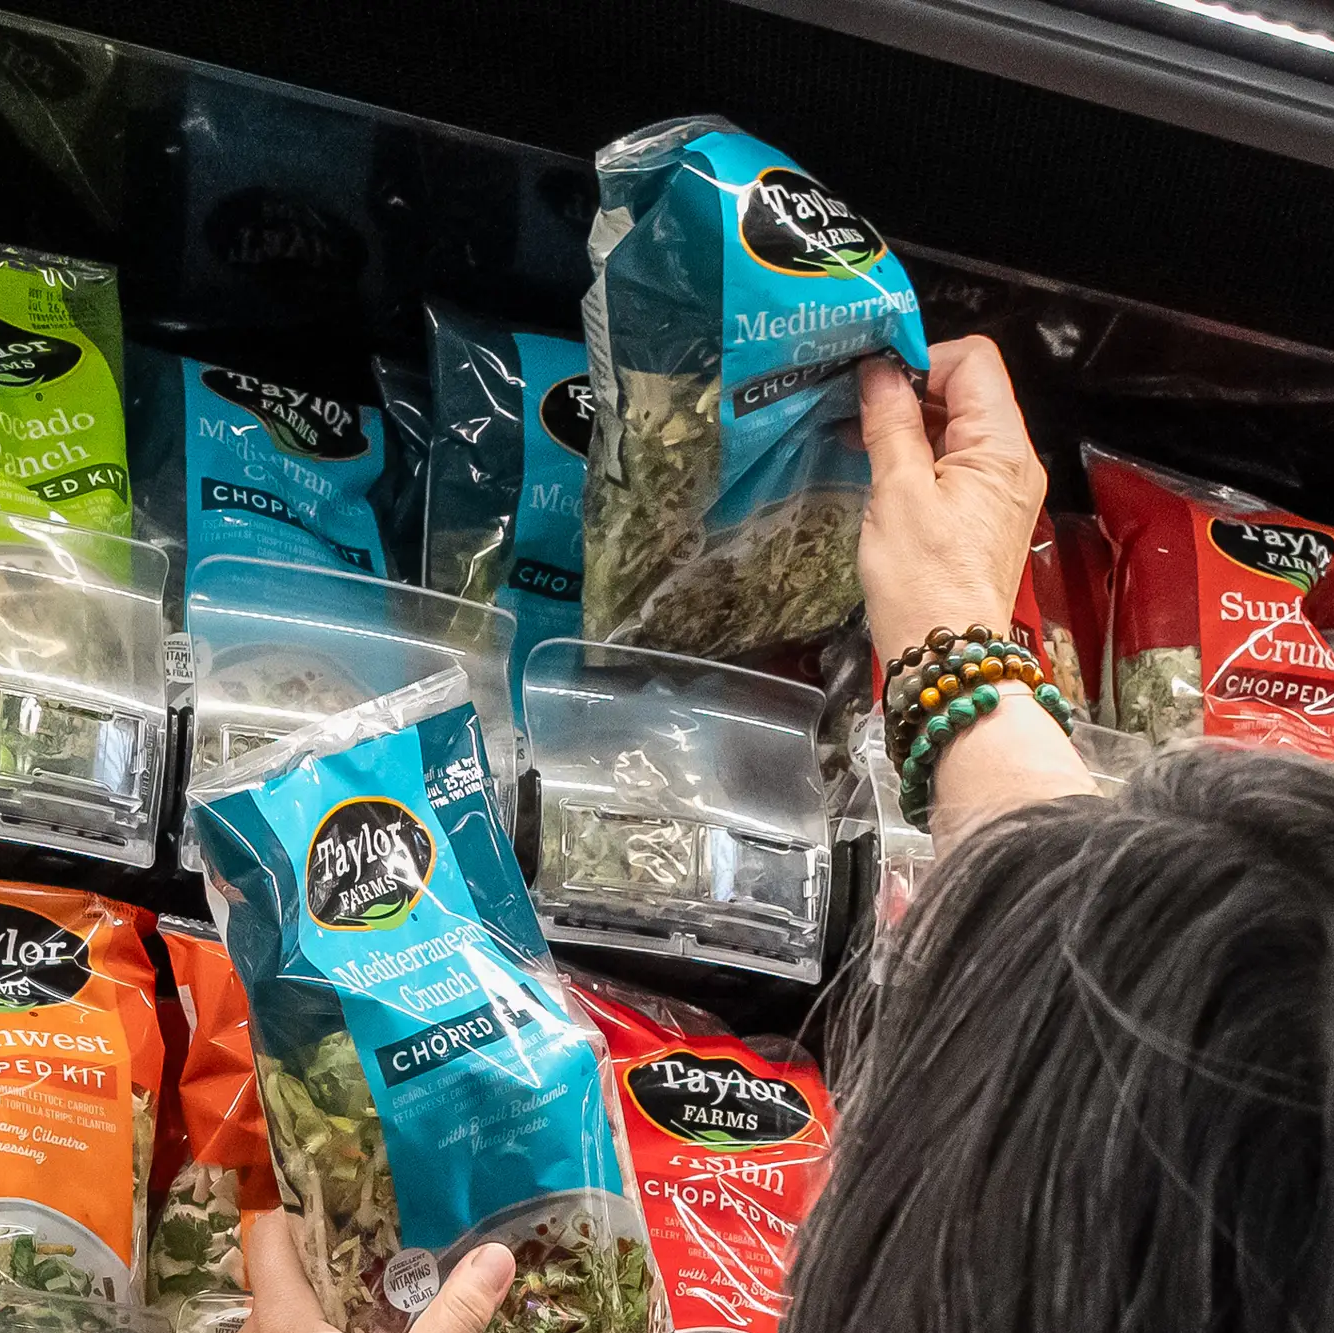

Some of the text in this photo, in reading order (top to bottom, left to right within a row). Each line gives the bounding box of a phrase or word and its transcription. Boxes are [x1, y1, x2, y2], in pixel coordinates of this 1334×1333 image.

[259, 398, 320, 447] FARMS
[1225, 676, 1325, 704] CHOPPED
[317, 819, 406, 881] Taylor
[338, 874, 398, 911] FARMS
[333, 921, 485, 994] Mediterranean
[400, 966, 478, 1012] Crunch
[392, 1016, 493, 1073] CHOPPED
[62, 1064, 108, 1089] KIT
[649, 1060, 787, 1106] Taylor
[438, 1083, 569, 1149] with Basil Balsamic
[469, 1116, 551, 1156] Vinaigrette
[681, 1104, 759, 1131] FARMS
[32, 1125, 88, 1152] Cilantro
[389, 1264, 431, 1292] VITAMINS
[410, 1288, 435, 1307] FOLATE
